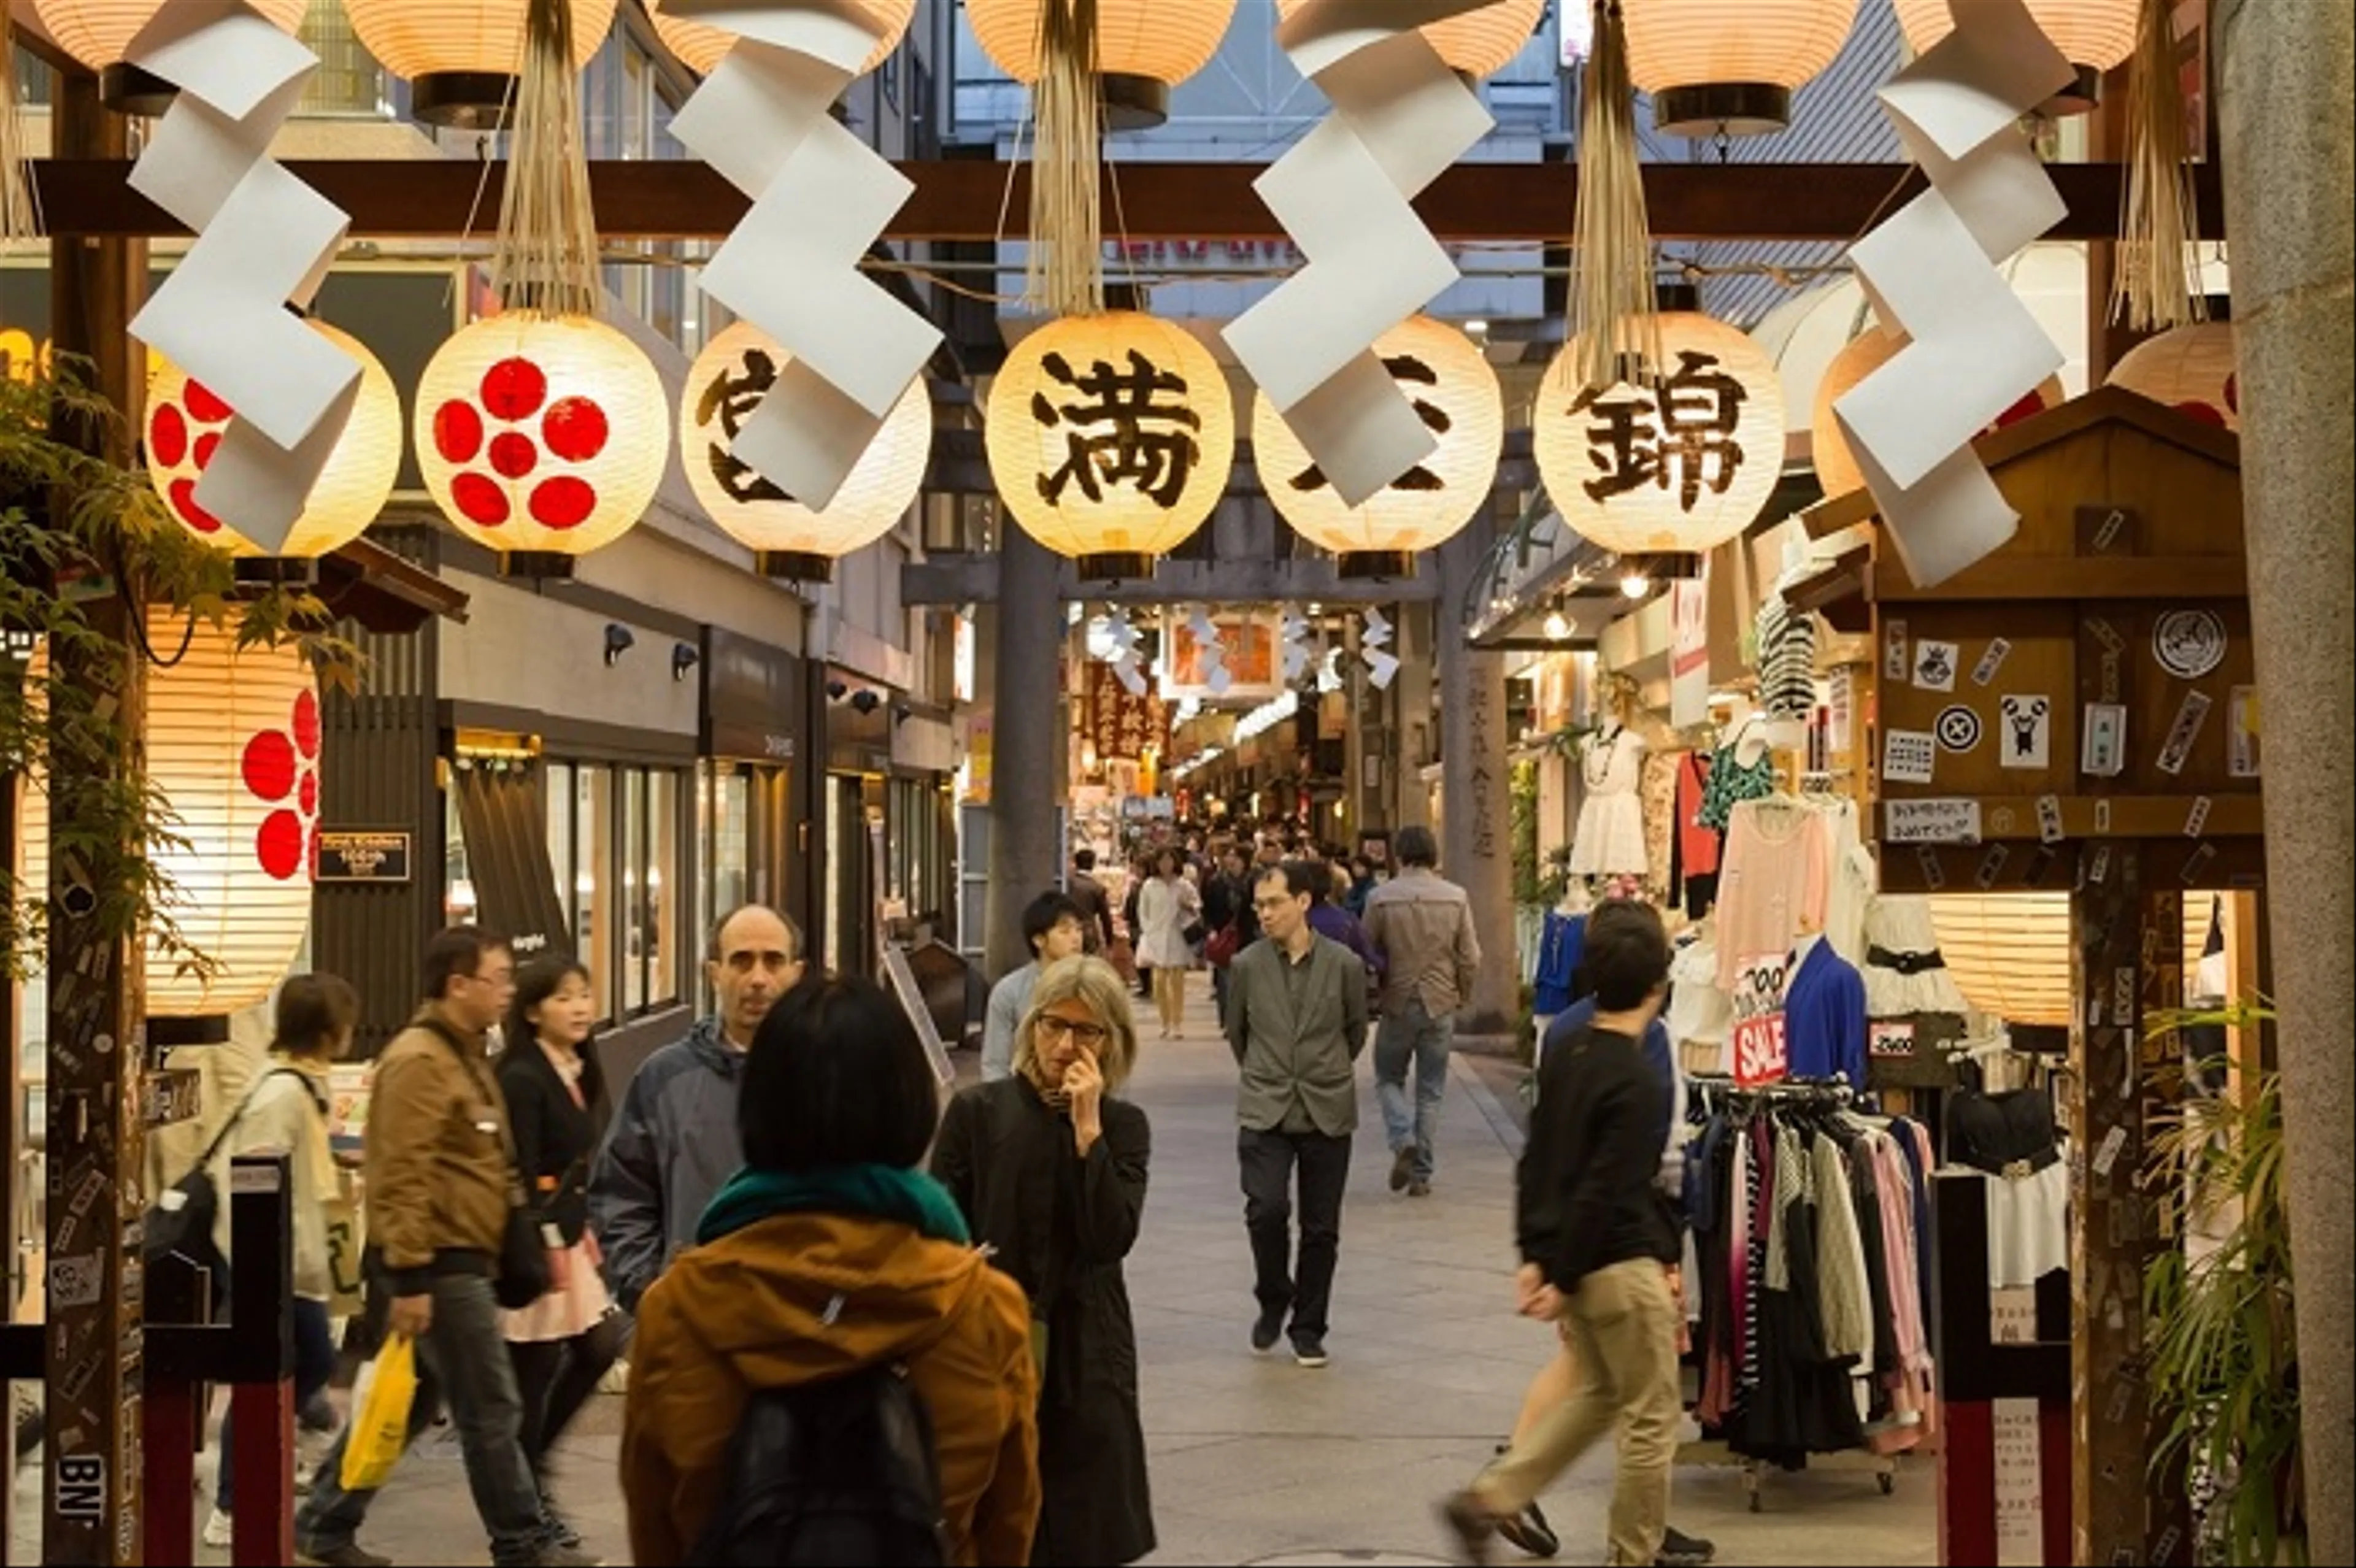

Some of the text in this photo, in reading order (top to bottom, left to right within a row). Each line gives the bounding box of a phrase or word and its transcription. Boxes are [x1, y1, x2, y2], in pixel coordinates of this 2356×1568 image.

[1031, 348, 1201, 509] 満
[1566, 350, 1749, 513] 錦
[1739, 1020, 1786, 1079] SALE
